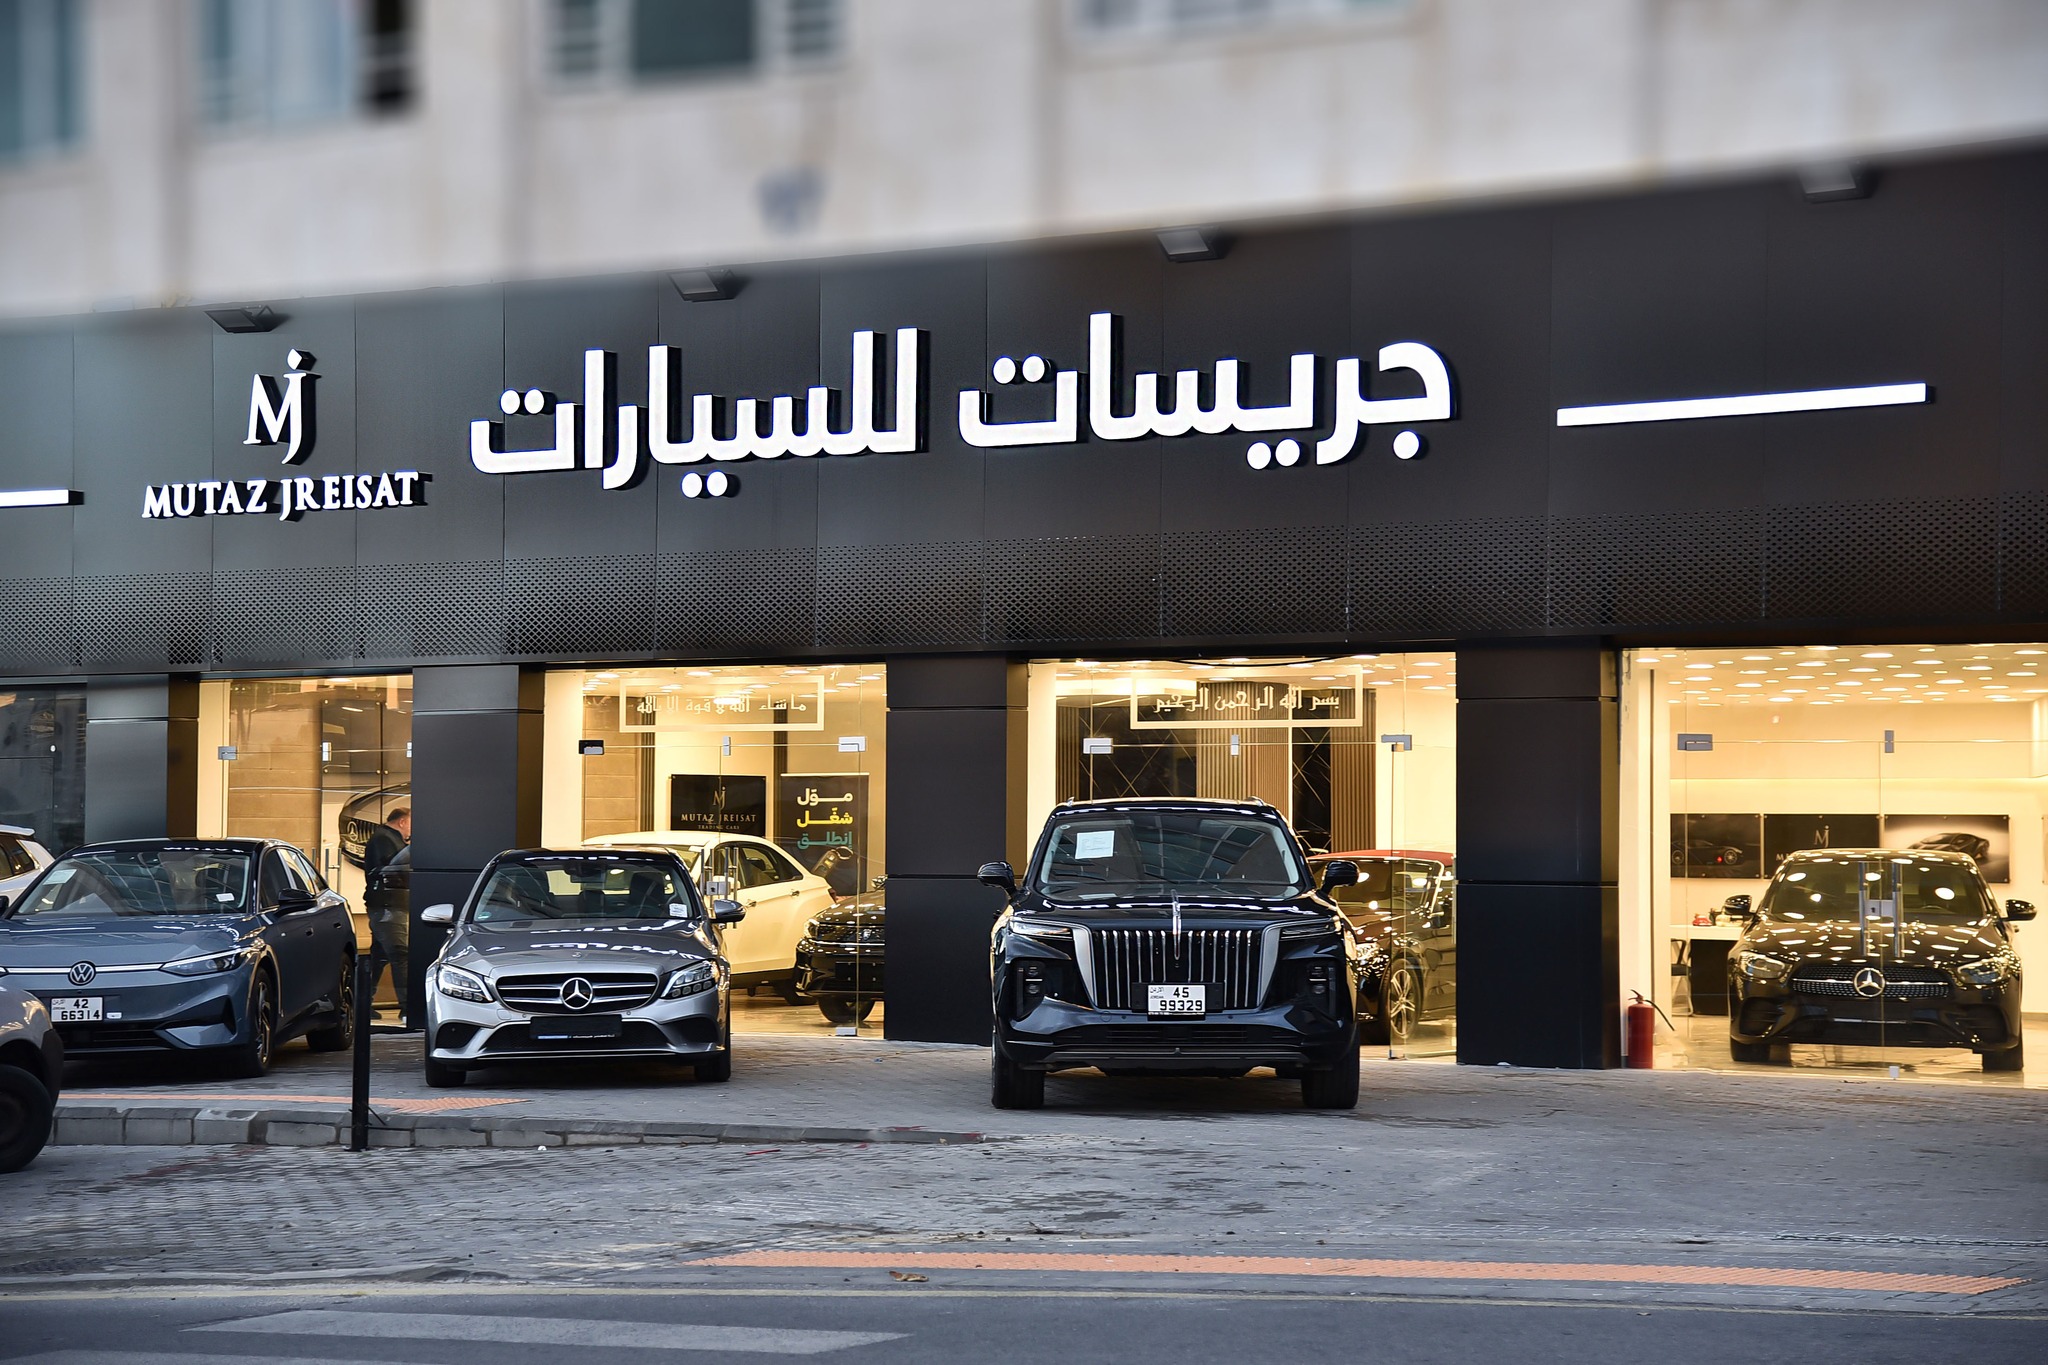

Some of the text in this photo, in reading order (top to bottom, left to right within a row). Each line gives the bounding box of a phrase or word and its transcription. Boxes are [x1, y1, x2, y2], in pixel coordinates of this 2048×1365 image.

[470, 312, 1452, 499] جريسات للسيارات
[141, 471, 420, 522] MUTAZ JREISAT
[790, 693, 807, 712] ما
[1153, 686, 1209, 713] الرحيم
[1279, 684, 1302, 710] الله
[1308, 695, 1340, 711] بسم
[680, 813, 715, 822] MUTAZ
[797, 831, 853, 850] إنطلق
[1173, 986, 1190, 999] 45
[73, 998, 89, 1009] 42
[1159, 1000, 1203, 1011] 99329
[61, 1009, 100, 1020] 66314
